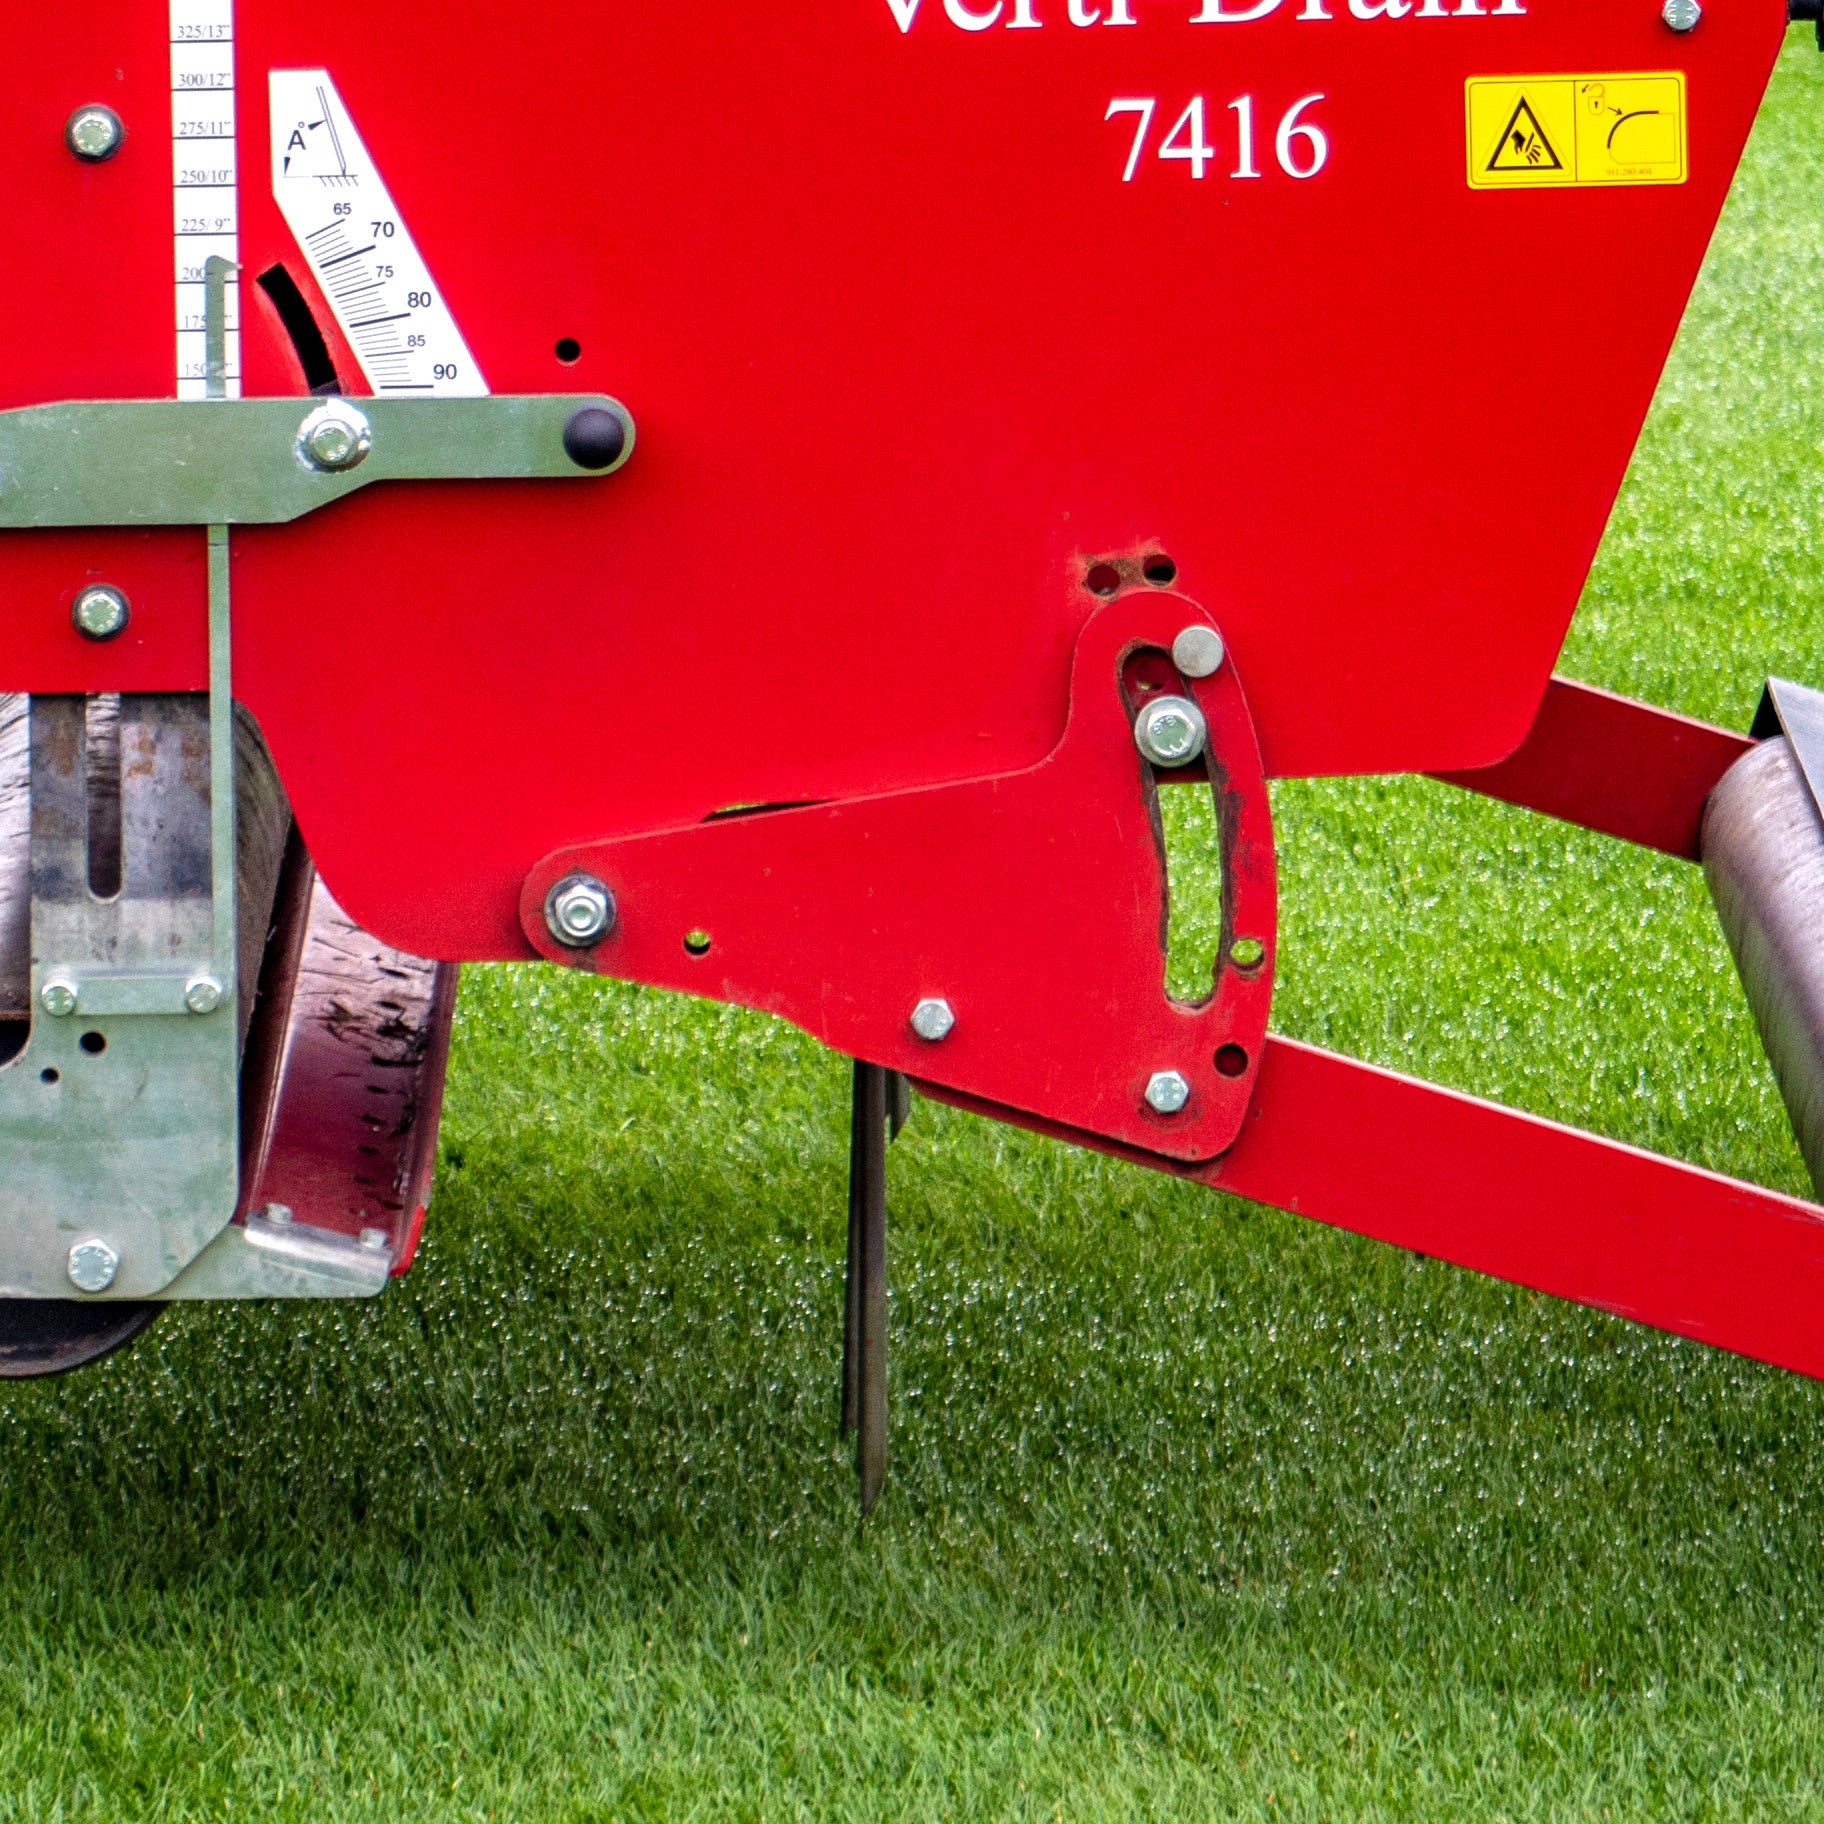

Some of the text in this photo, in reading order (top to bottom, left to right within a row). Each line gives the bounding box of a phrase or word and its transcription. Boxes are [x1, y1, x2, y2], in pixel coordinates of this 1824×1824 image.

[1101, 92, 1330, 183] 7416
[333, 202, 352, 216] 65
[370, 221, 395, 238] 70
[375, 265, 394, 278] 75
[407, 291, 432, 308] 80
[407, 334, 426, 347] 85
[432, 363, 458, 380] 90
